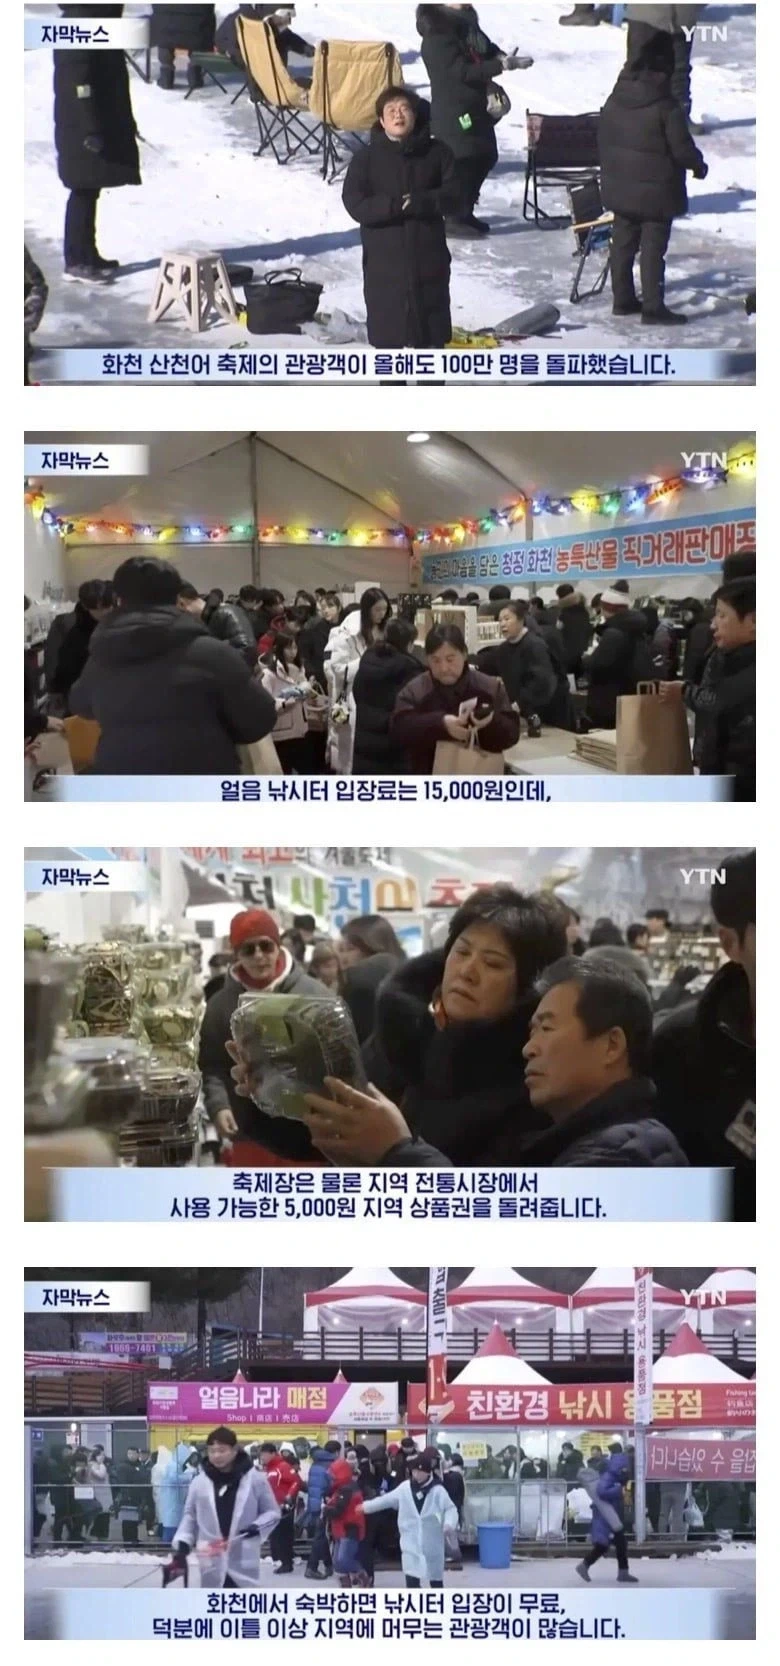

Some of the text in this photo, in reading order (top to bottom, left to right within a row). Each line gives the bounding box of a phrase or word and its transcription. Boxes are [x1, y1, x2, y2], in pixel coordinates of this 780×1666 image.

[480, 553, 499, 577] 담은
[502, 550, 525, 576] 청정
[526, 546, 553, 574] 화천
[556, 537, 619, 574] 농특산물
[199, 1386, 328, 1410] 얼음나라 매점
[467, 1389, 550, 1421] 친환경
[558, 1389, 612, 1420] 낚시
[226, 1414, 247, 1423] Shop
